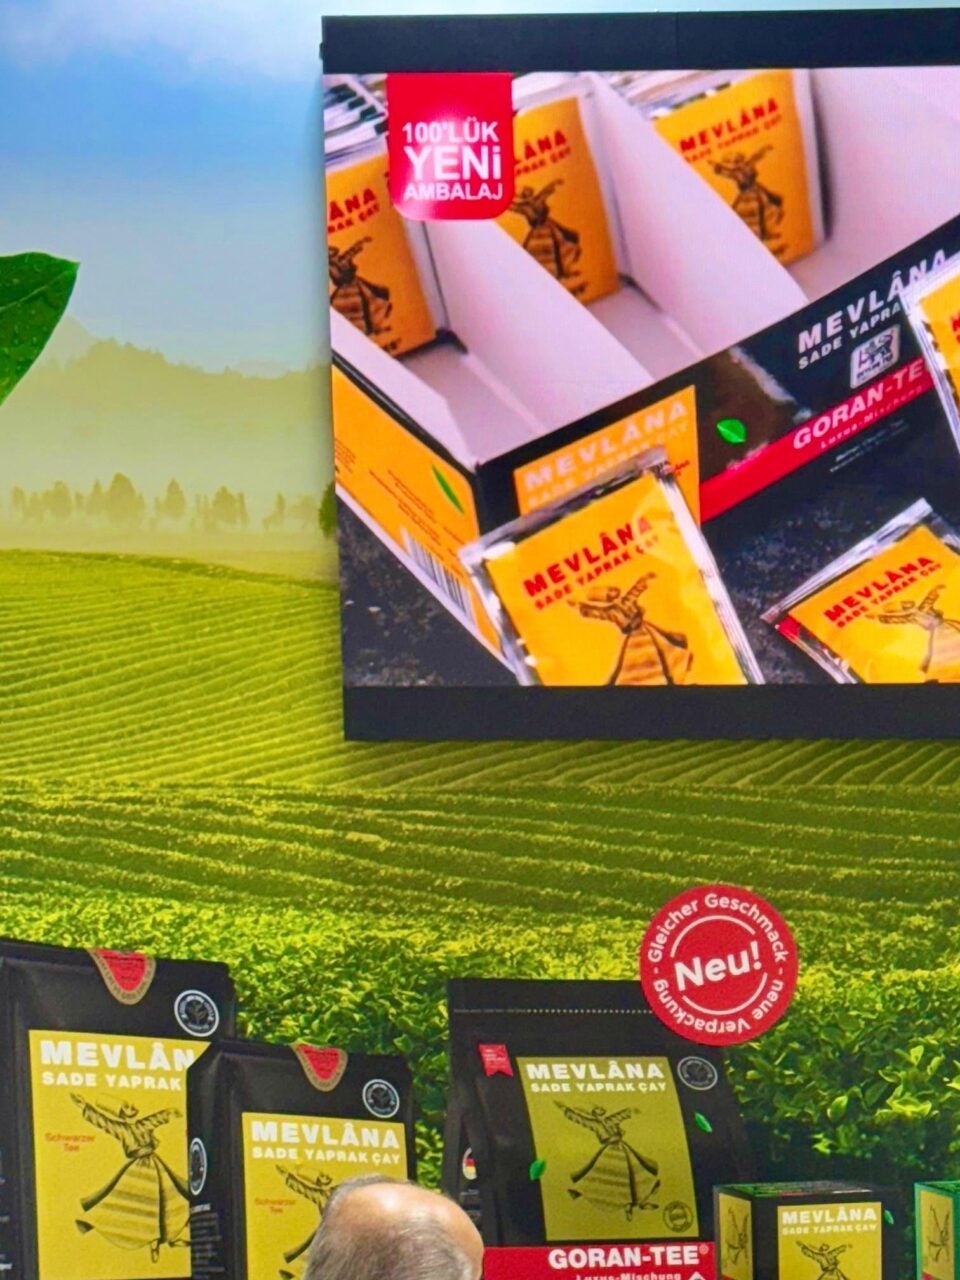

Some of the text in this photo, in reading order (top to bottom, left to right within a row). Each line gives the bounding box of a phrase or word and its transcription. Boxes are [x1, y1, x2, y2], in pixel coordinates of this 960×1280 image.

[402, 116, 499, 143] 100'LÜK
[403, 182, 503, 200] AMBALAJ
[799, 336, 842, 369] SADE
[849, 302, 901, 339] YAPRA
[793, 357, 925, 449] GORAN-TE
[647, 893, 789, 1034] Gleicher Geschmack neue Verpackung
[674, 940, 762, 991] Neu!
[40, 1040, 196, 1072] MEVLÂN
[42, 1071, 182, 1091] SADE YAPRAK
[526, 1060, 665, 1080] MEVLÂNA
[531, 1082, 667, 1095] SADE YAPRAK ÇAY
[251, 1121, 400, 1149] MEVLÂNA
[252, 1147, 400, 1167] SADE YAPRAK ÇAY
